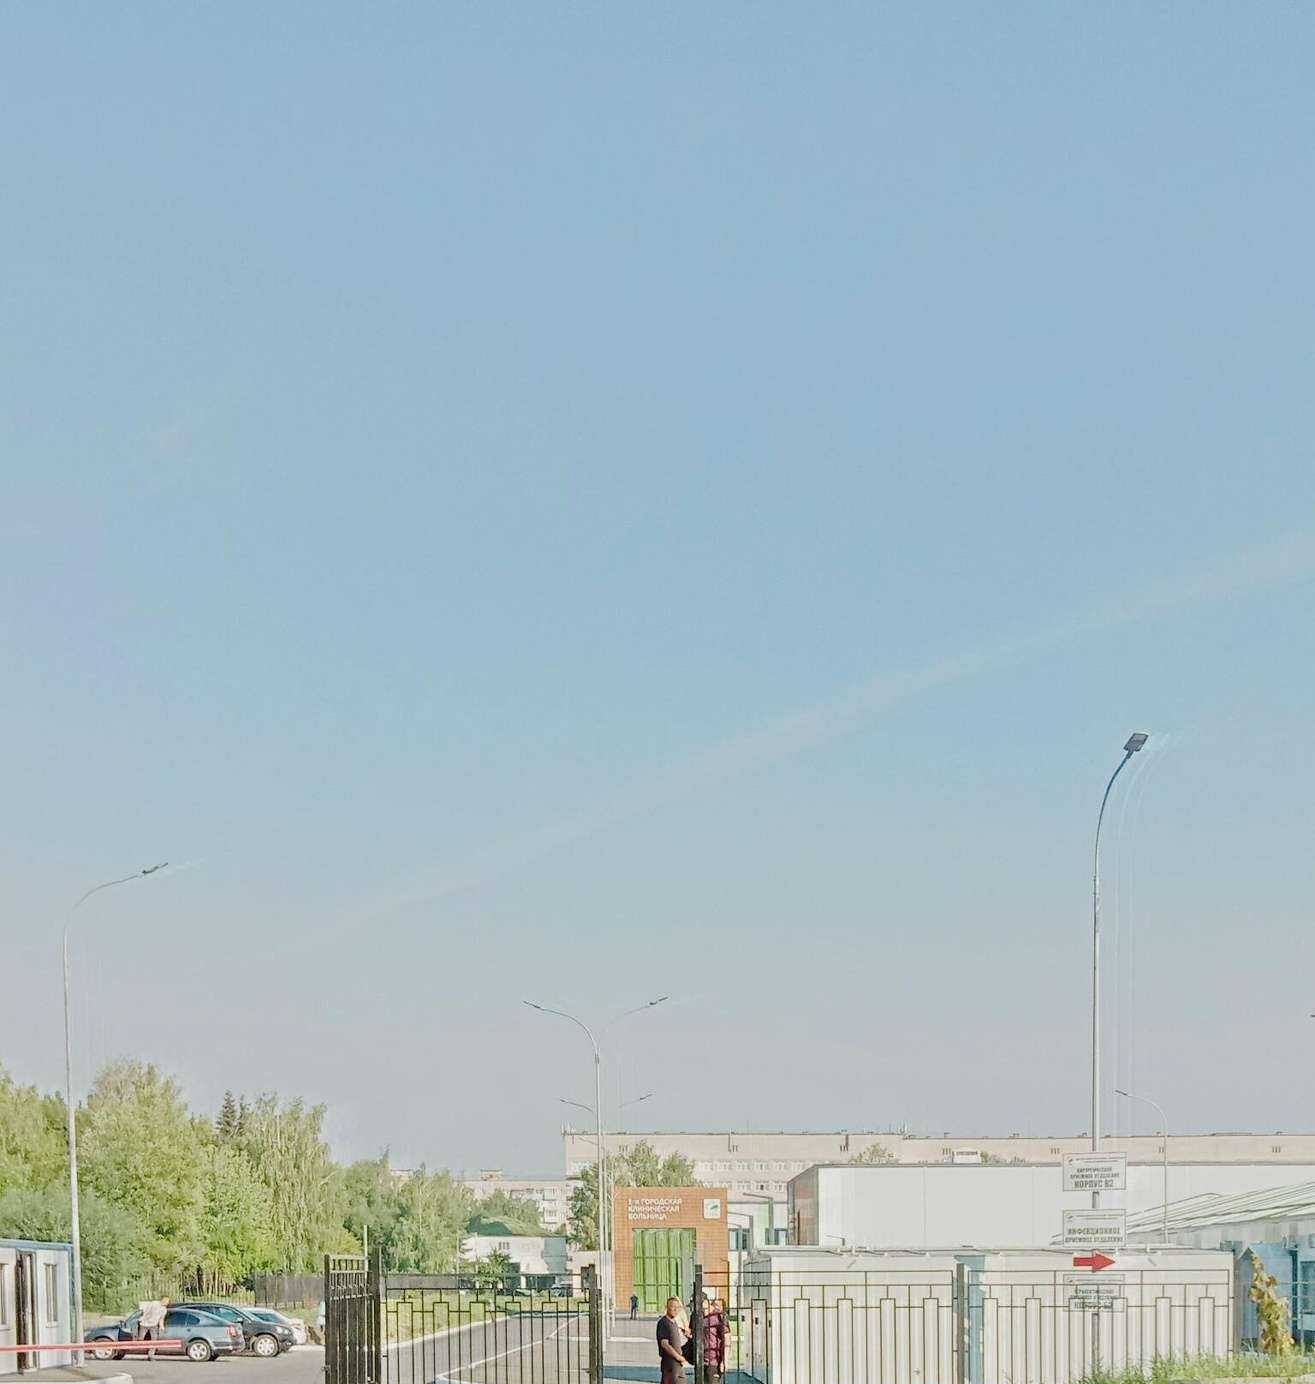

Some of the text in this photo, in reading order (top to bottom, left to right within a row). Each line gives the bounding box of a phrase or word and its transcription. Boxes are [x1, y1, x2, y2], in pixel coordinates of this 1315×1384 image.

[1074, 1180, 1103, 1188] КОРПУС
[641, 1197, 682, 1206] ГОРОДСКАЯ
[628, 1205, 680, 1213] КЛИНИЧЕСКАЯ
[628, 1212, 668, 1221] БОЛЬНИЦА
[1068, 1227, 1120, 1235] ИНФЕКЦИОННОЕ
